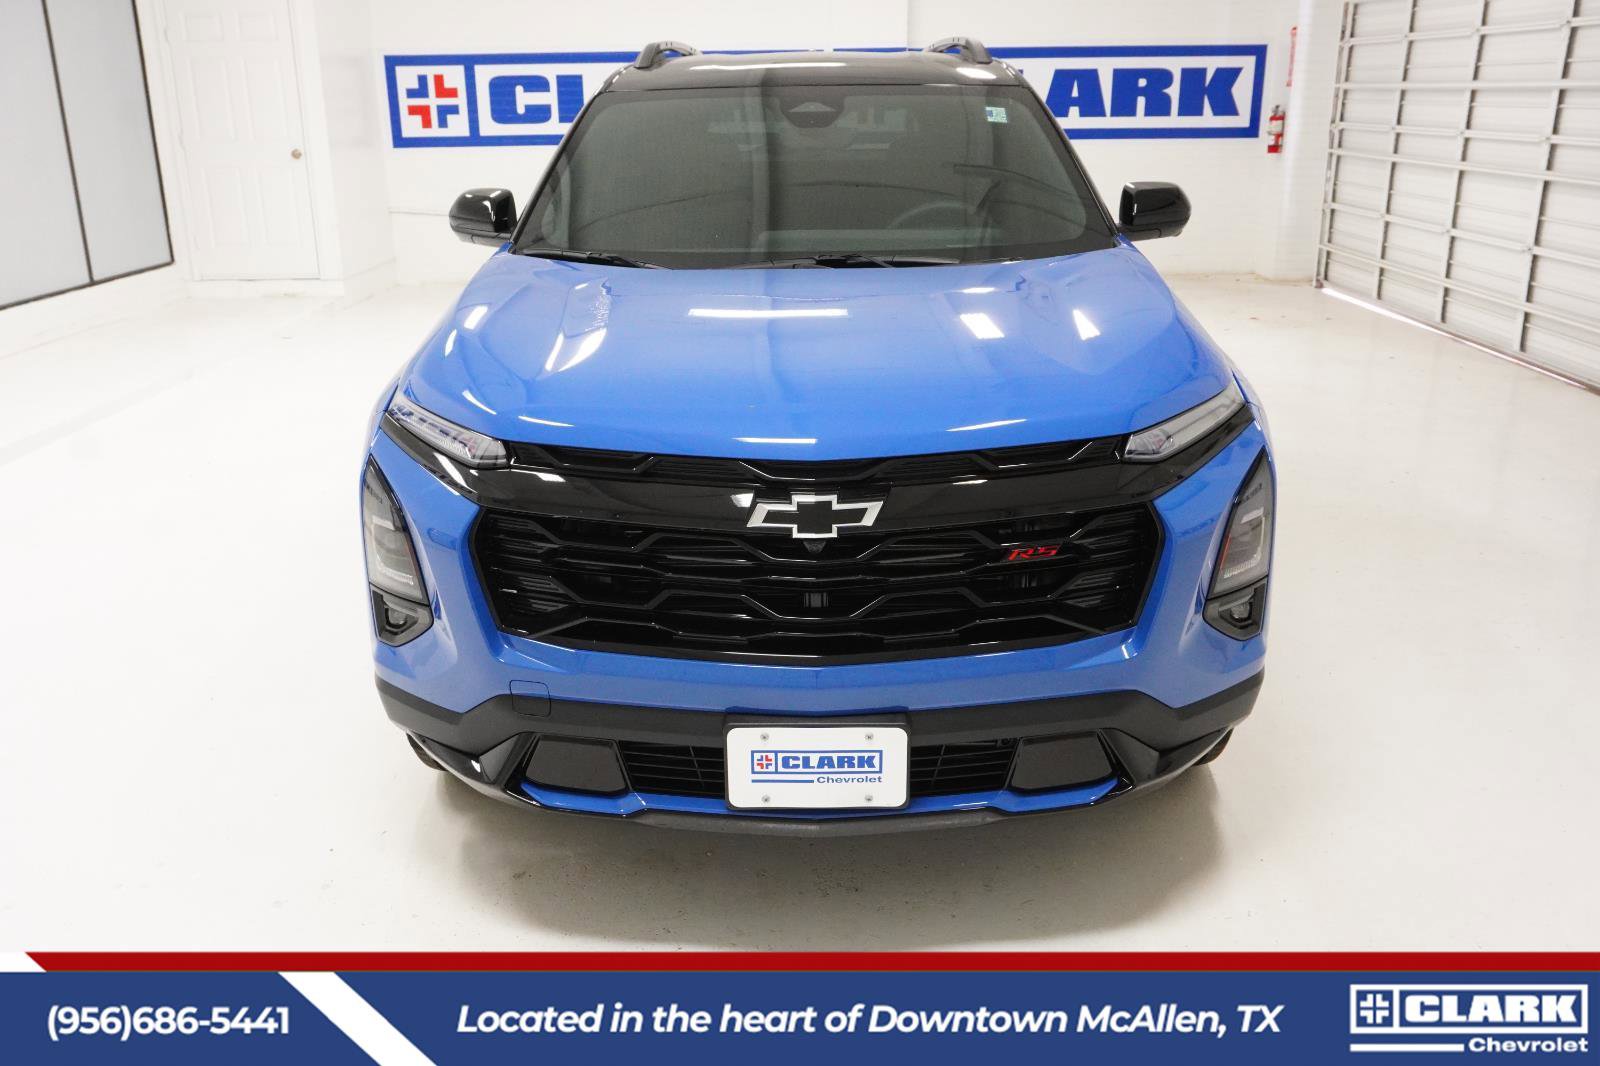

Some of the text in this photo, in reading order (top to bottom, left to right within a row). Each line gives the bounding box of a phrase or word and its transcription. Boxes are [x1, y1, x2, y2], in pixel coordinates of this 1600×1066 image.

[1045, 66, 1243, 118] ARK
[1008, 545, 1058, 561] RS
[781, 755, 876, 770] CLARK
[816, 775, 883, 784] Chevrolet
